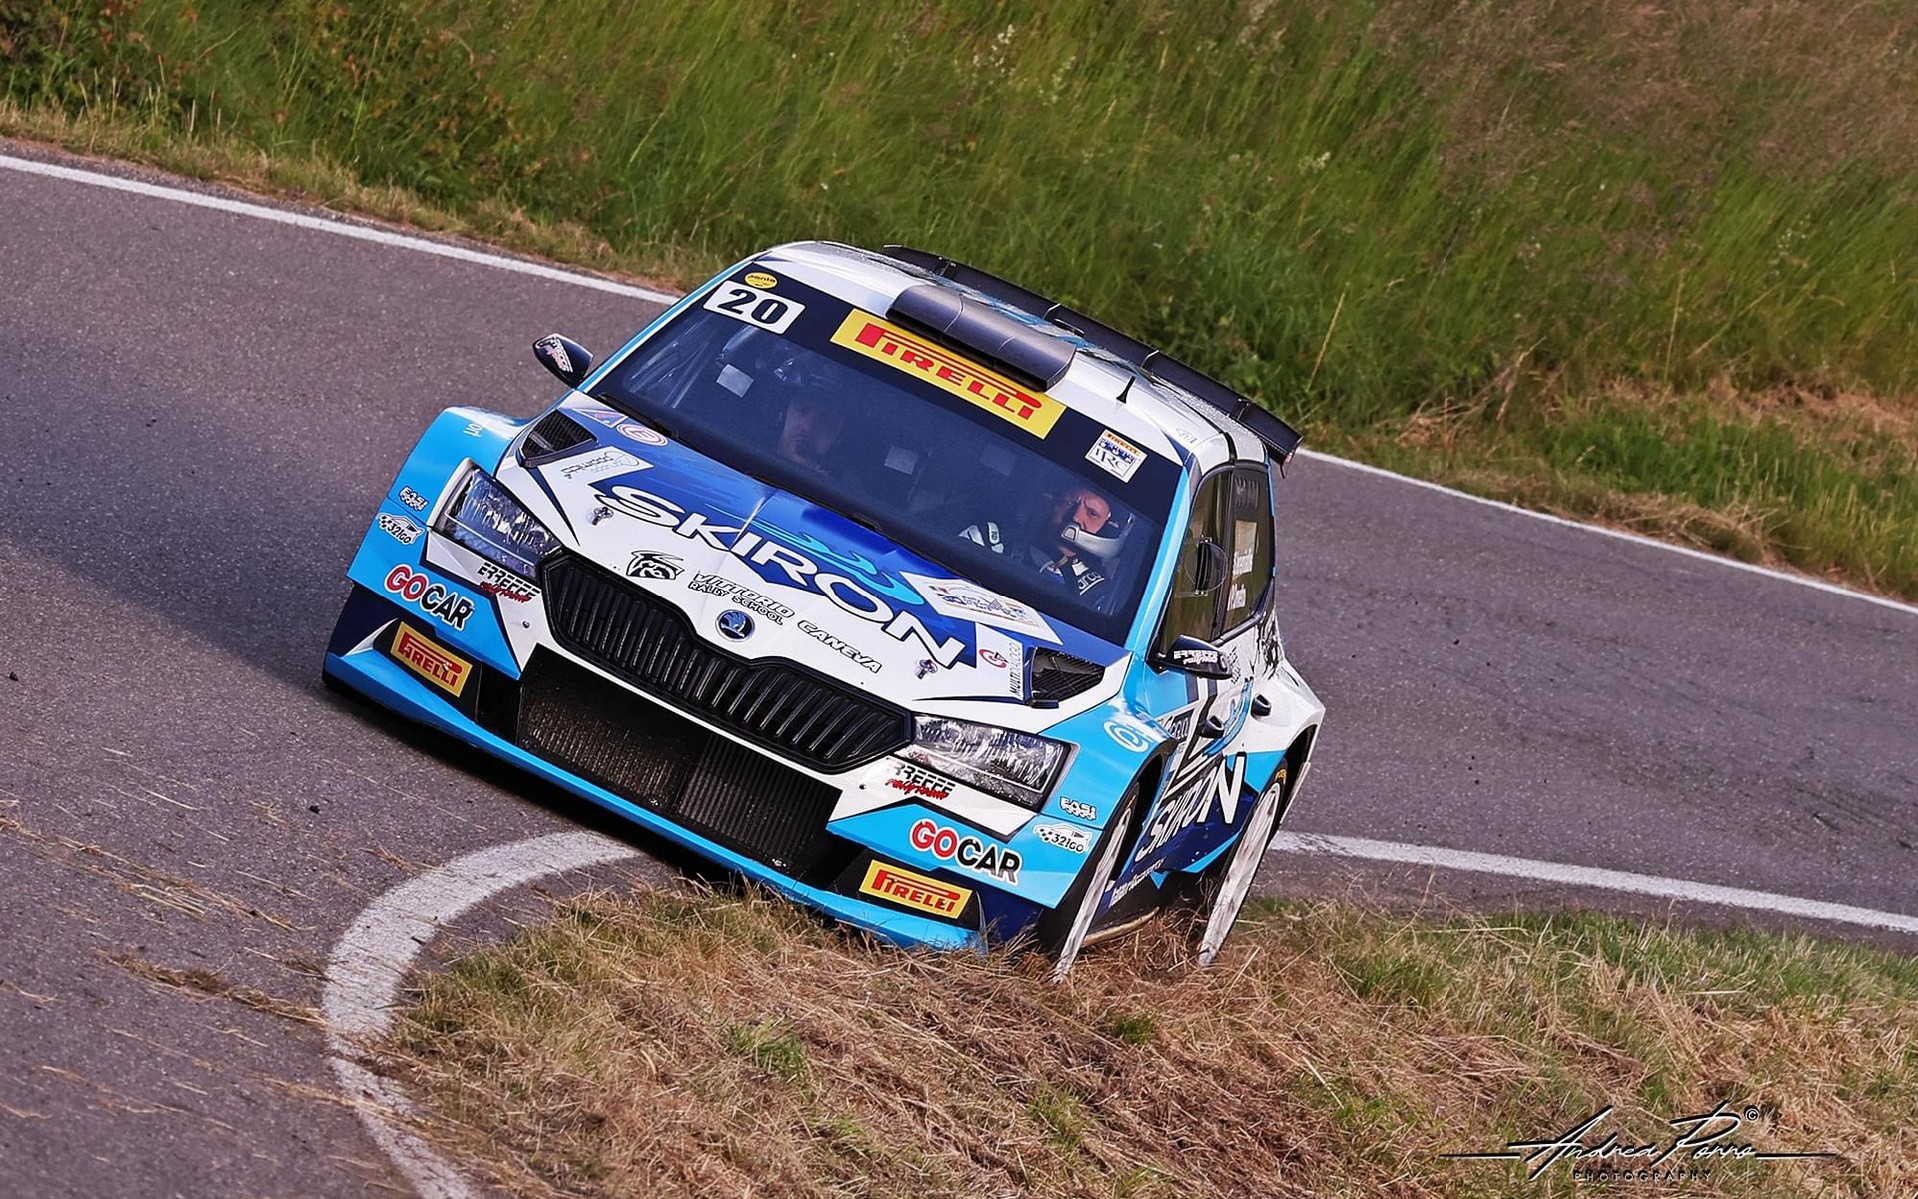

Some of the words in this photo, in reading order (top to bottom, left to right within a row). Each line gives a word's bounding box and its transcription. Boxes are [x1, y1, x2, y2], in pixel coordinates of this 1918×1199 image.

[717, 288, 788, 324] 20
[855, 322, 1043, 421] PIRELLI
[385, 565, 474, 631] GOCAR
[596, 484, 967, 670] SKIRON
[688, 580, 729, 598] RALLY
[731, 595, 785, 626] SCHOOL
[692, 572, 795, 619] VITTORIO
[797, 619, 884, 674] CANEVA
[397, 632, 463, 687] PIRELLI
[893, 761, 956, 792] RREFFE
[910, 819, 1022, 884] GOCAR
[871, 870, 962, 913] PIRELLI
